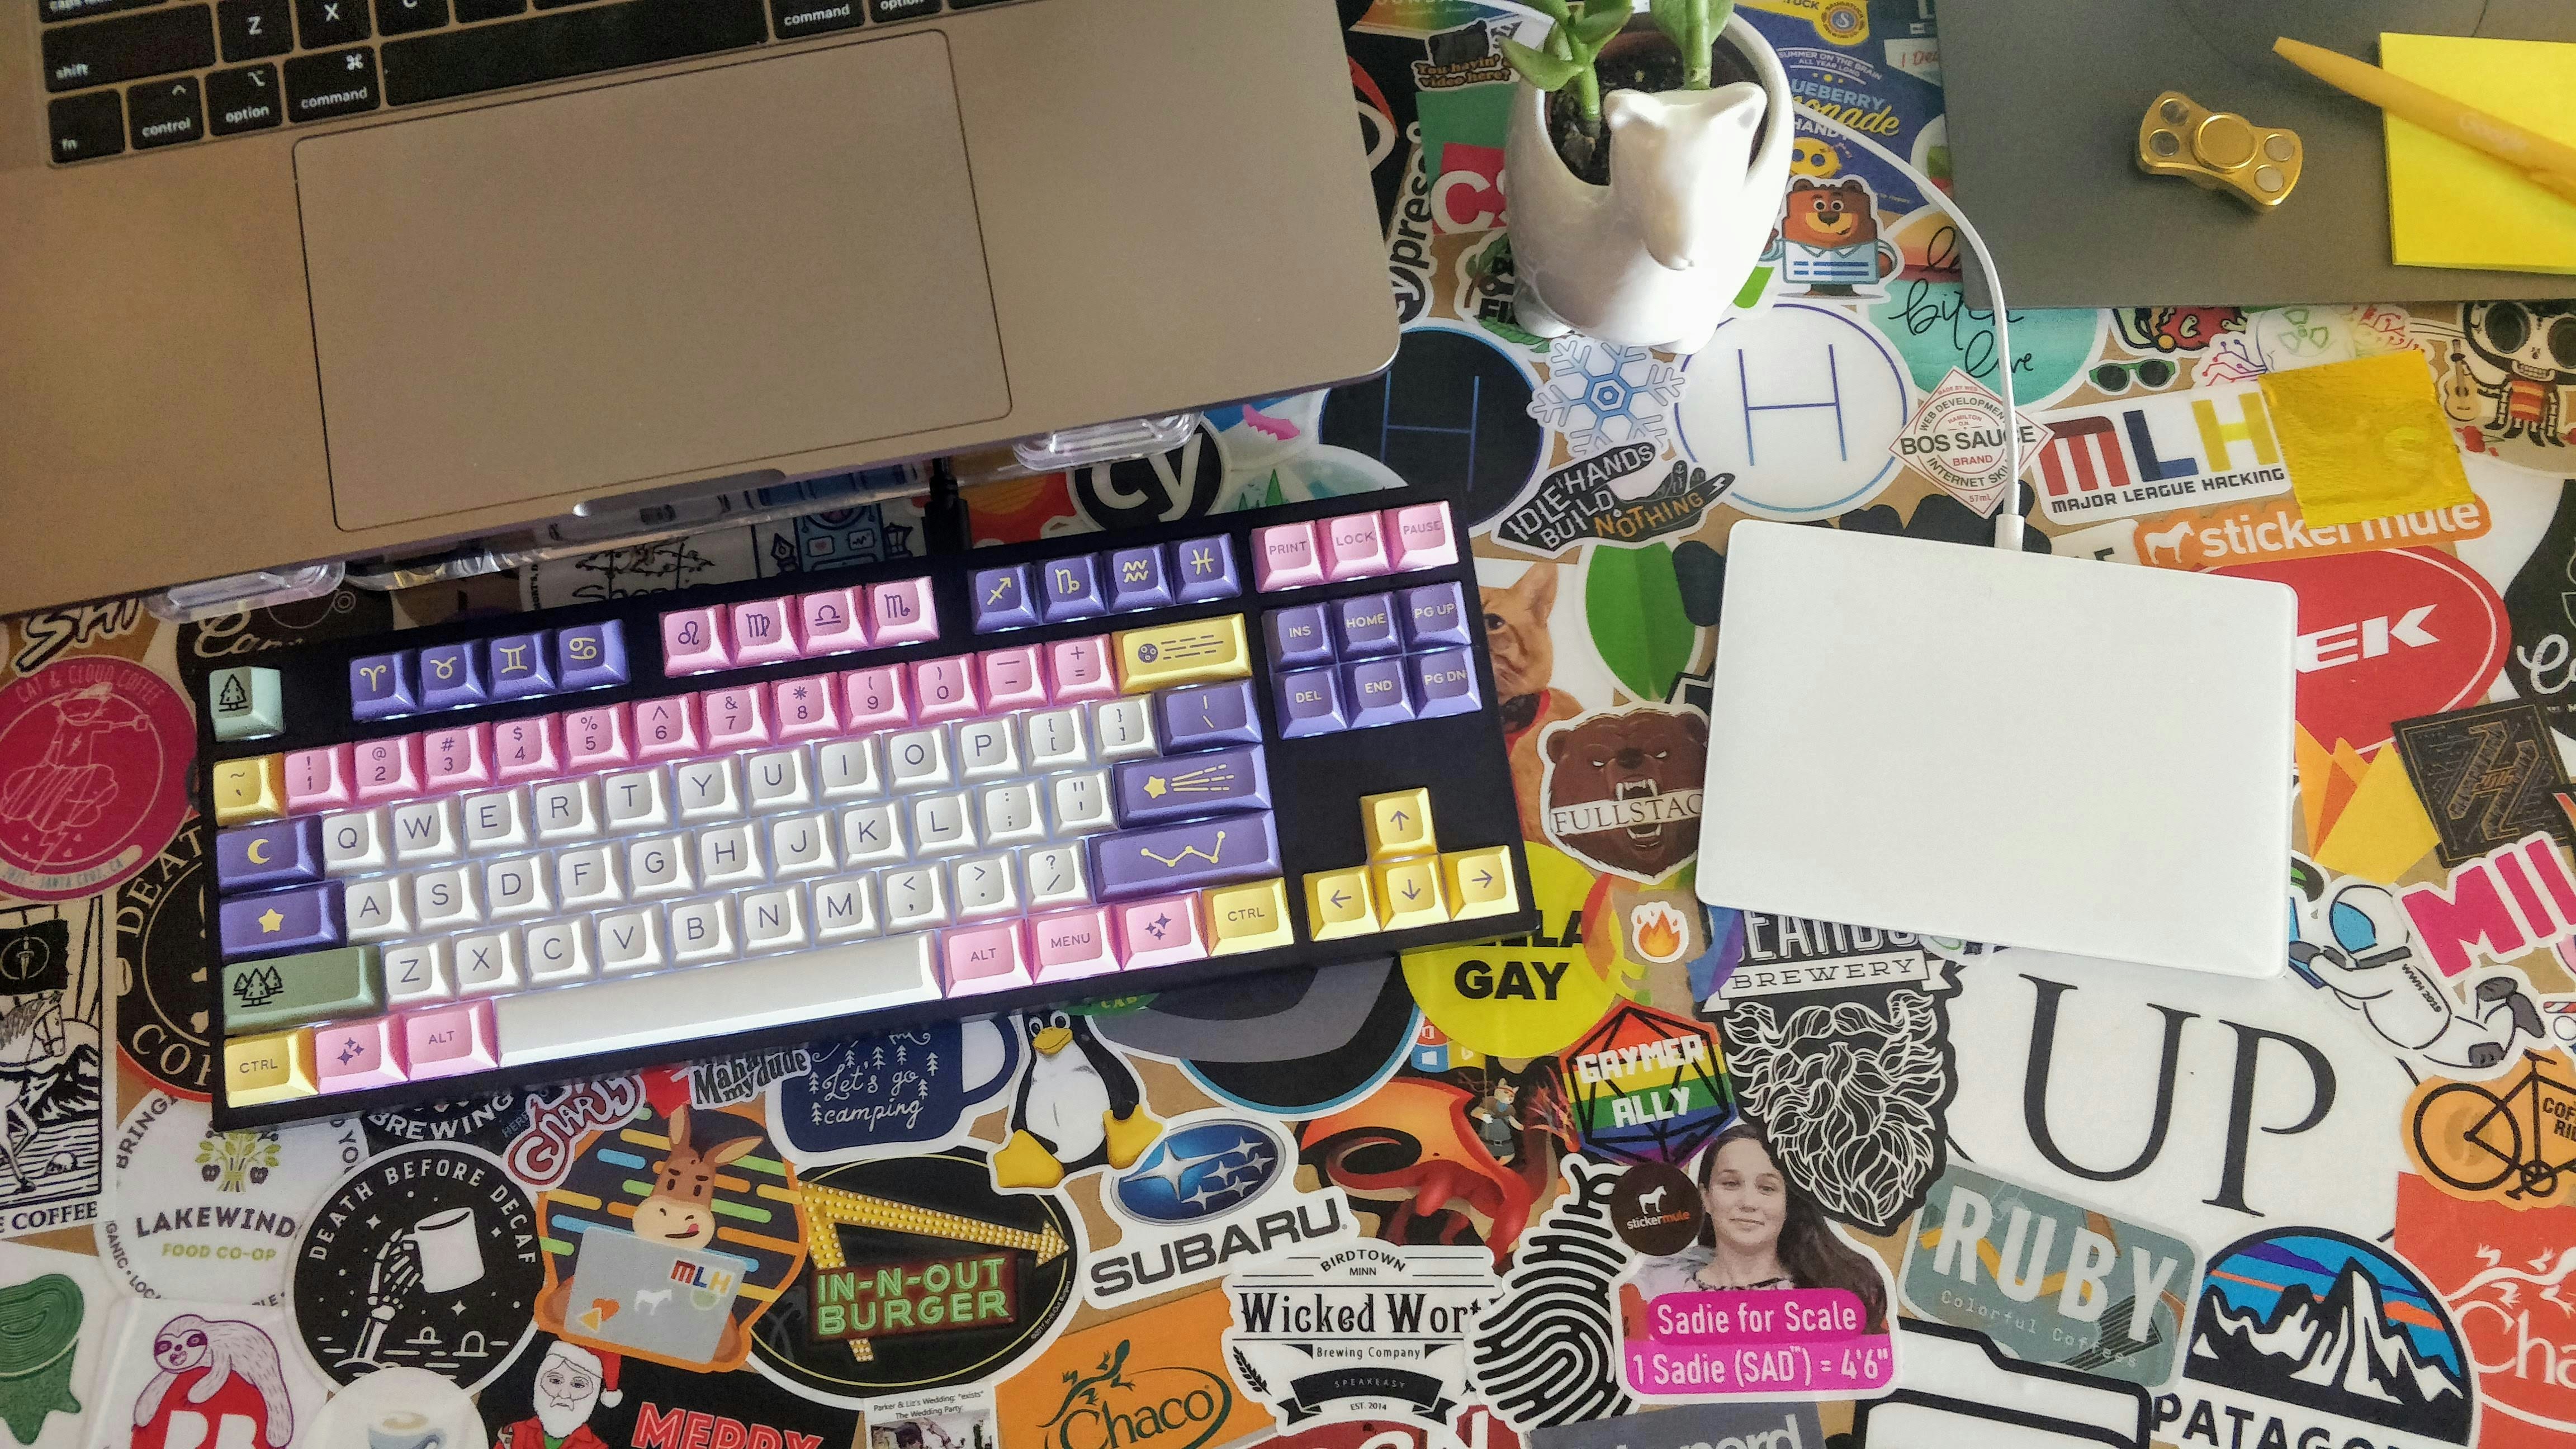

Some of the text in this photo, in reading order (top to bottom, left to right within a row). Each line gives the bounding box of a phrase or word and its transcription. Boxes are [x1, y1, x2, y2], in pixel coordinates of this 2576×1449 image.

[325, 4, 339, 21] X
[784, 3, 850, 27] command
[249, 17, 262, 35] Z
[56, 63, 88, 80] shift
[1816, 60, 1837, 69] YEAR
[1838, 66, 1860, 78] LONG
[1819, 54, 1835, 62] ON
[1836, 57, 1854, 67] THE
[1855, 63, 1883, 81] BRAIN
[301, 86, 368, 110] command
[1791, 78, 1886, 110] UEBERRY
[226, 104, 269, 124] option
[142, 117, 191, 138] control
[61, 138, 78, 151] fn
[1920, 397, 2005, 432] WEB DEVELOPMEN
[1947, 414, 1982, 424] HAMILTON
[1900, 425, 2037, 456] BOS SAUE
[2038, 391, 2279, 496] MLH
[1953, 454, 1993, 467] BRAND
[1926, 457, 1985, 488] INTERNET
[1507, 444, 1655, 542] IDLE HANDS
[2052, 467, 2285, 514] MAJOR LEAGUE HACKING
[1403, 520, 1443, 536] PAUSE
[1538, 489, 1704, 549] BUILD NOTHING
[1269, 540, 1309, 556] PRINT
[1336, 531, 1375, 547] LOCK
[1346, 613, 1387, 629] HOME
[1414, 603, 1456, 619] PG UP
[1289, 626, 1312, 638] INS
[2297, 604, 2440, 673] EK
[1364, 680, 1393, 694] END
[1424, 670, 1467, 686] PG DN
[866, 696, 879, 710] 9
[936, 685, 950, 700] 0
[1295, 691, 1322, 704] DEL
[724, 716, 736, 730] 7
[797, 705, 808, 720] 8
[585, 736, 596, 751] 5
[655, 725, 667, 740] 6
[514, 746, 527, 760] 4
[905, 744, 925, 765] O
[974, 733, 992, 757] P
[375, 766, 387, 781] 2
[443, 757, 454, 772] 3
[764, 764, 783, 786] U
[842, 755, 848, 776] I
[307, 776, 313, 790] 1
[692, 774, 713, 797] Y
[551, 795, 569, 819] R
[621, 784, 638, 807] T
[481, 805, 499, 828] E
[930, 811, 949, 832] L
[1552, 793, 1703, 834] FULLSTAC
[338, 827, 358, 850] Q
[403, 815, 433, 840] W
[858, 819, 878, 843] K
[714, 840, 736, 864] H
[791, 830, 807, 853] J
[574, 862, 591, 886] F
[645, 851, 665, 874] G
[116, 825, 202, 938] DEAT
[501, 873, 522, 895] D
[359, 895, 381, 918] A
[431, 884, 449, 906] S
[827, 893, 853, 918] M
[758, 904, 779, 927] N
[1227, 907, 1266, 922] CTRL
[613, 926, 634, 950] V
[686, 917, 705, 940] B
[1051, 932, 1091, 948] MENU
[472, 947, 490, 972] X
[543, 937, 562, 960] C
[970, 948, 997, 963] ALT
[399, 959, 420, 983] Z
[1455, 959, 1571, 1001] GAY
[1732, 957, 1916, 989] BREWERY
[428, 1031, 456, 1045] ALT
[239, 1059, 278, 1074] CTRL
[1576, 1034, 1707, 1083] GAYMER
[723, 1072, 754, 1101] my
[822, 1060, 920, 1101] Let's go
[2018, 972, 2337, 1218] UP
[367, 1088, 514, 1140] BREWING
[824, 1098, 924, 1132] camping
[1612, 1087, 1690, 1129] ALLY
[11, 1201, 98, 1230] COFFEE
[136, 1205, 297, 1239] LAKEWIND
[308, 1158, 537, 1264] DEATH BEFORE DECAF
[1627, 1209, 1691, 1230] stickermule
[162, 1243, 277, 1261] FOOD CO-OP
[1091, 1197, 1341, 1298] SUBARU
[1319, 1248, 1407, 1273] BIRDTOWN
[1349, 1267, 1377, 1277] MINN
[1932, 1184, 2178, 1343] RUBY
[671, 1260, 732, 1292] MLH
[816, 1257, 1006, 1305] IN-N-OUT
[818, 1289, 1010, 1337] BURGER
[1239, 1292, 1385, 1334] Wicked
[1656, 1301, 1857, 1335] Sadie for Scale
[1940, 1290, 2138, 1368] Colorful Coffees
[1317, 1346, 1421, 1361] Brewing Company
[1632, 1354, 1645, 1385] 1
[1651, 1351, 1726, 1385] Sadie
[1333, 1377, 1407, 1389] SPEAKEASY
[873, 1403, 897, 1412] Parker
[911, 1408, 943, 1417] Wedding
[1350, 1401, 1388, 1411] EST. 2014
[1060, 1389, 1215, 1449] Chaco
